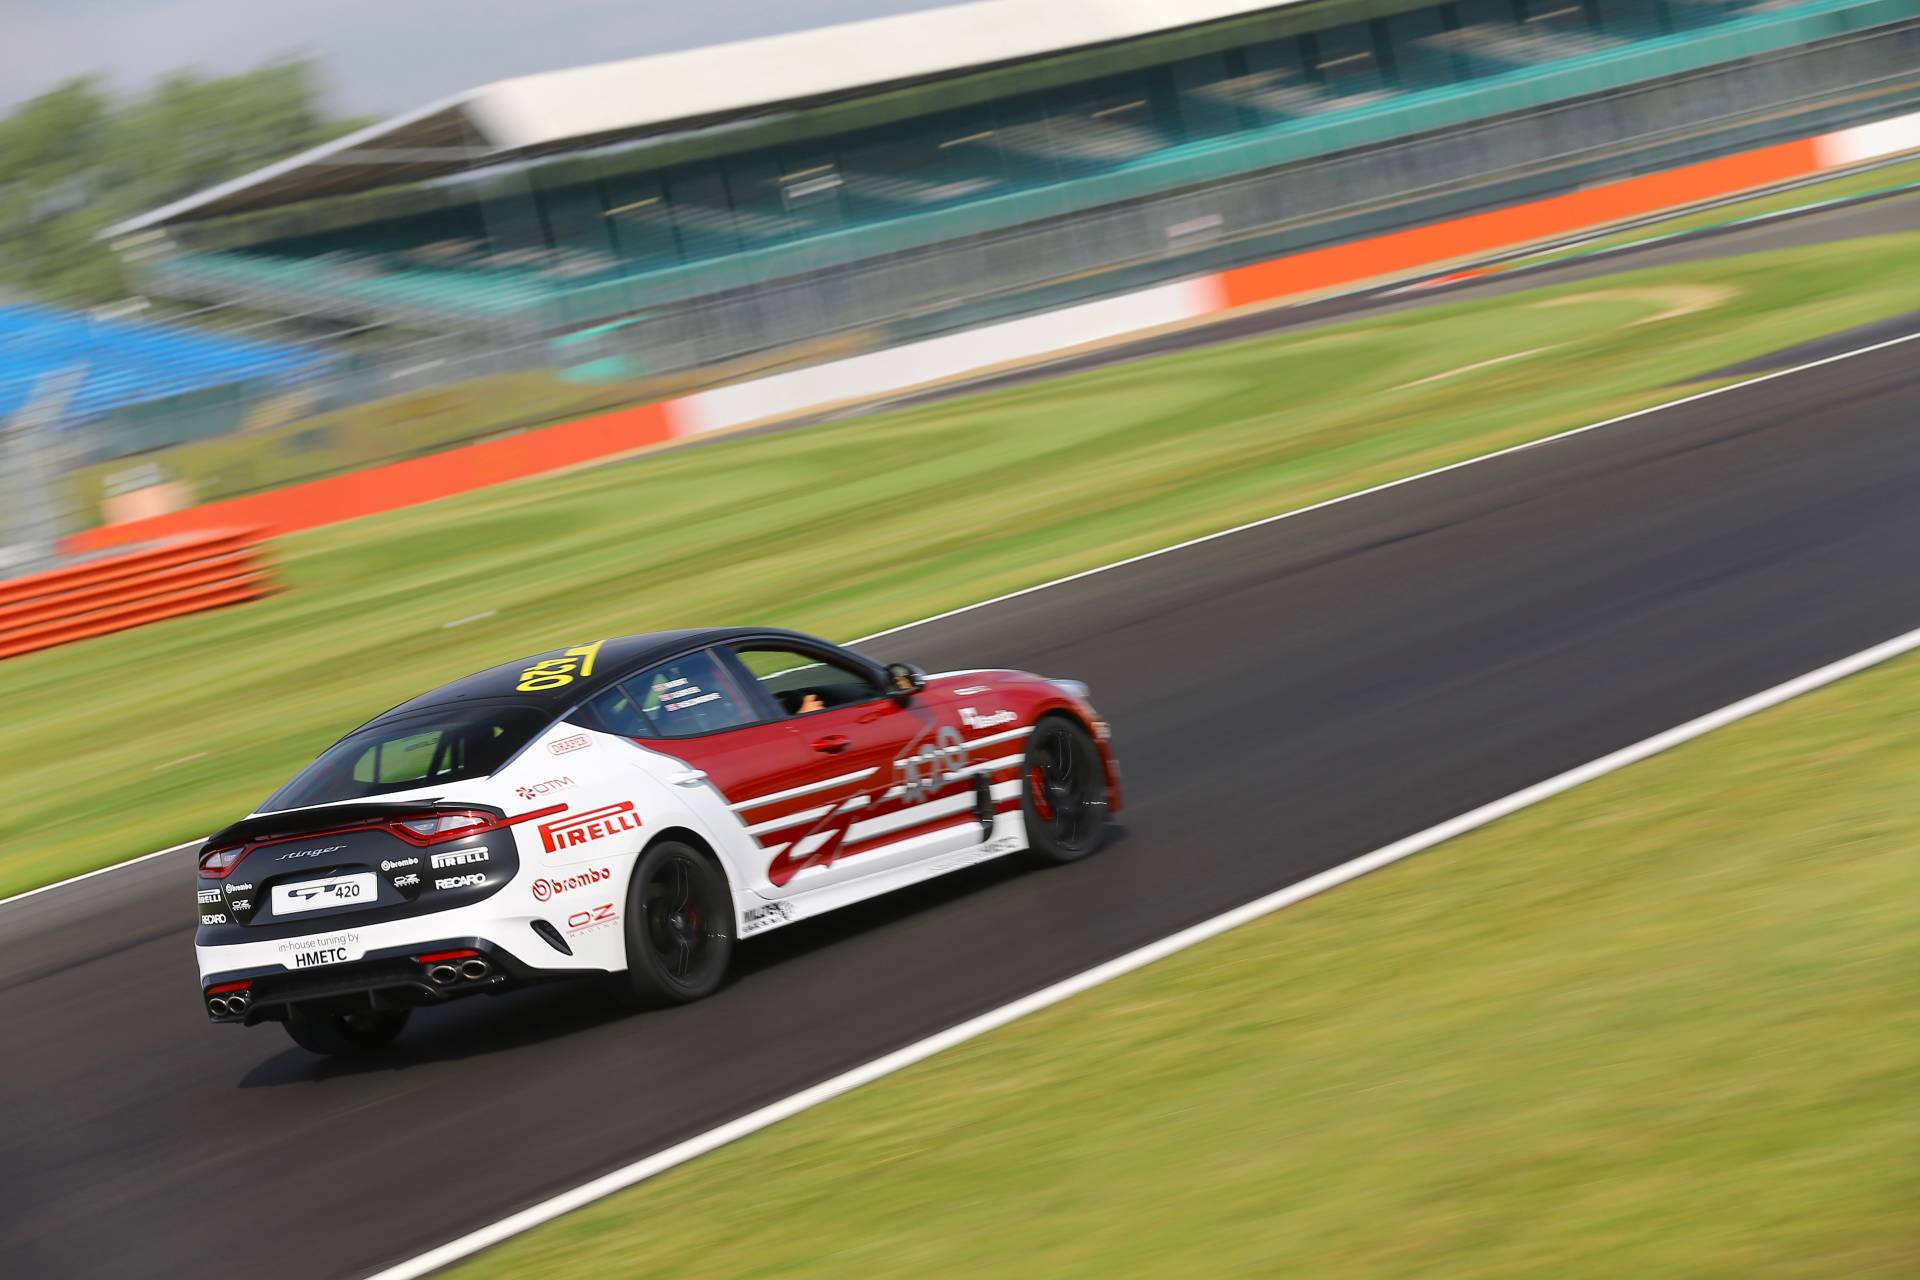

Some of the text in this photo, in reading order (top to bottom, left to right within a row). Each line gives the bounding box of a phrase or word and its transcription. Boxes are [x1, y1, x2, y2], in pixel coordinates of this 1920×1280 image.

[515, 657, 578, 692] 420
[537, 800, 643, 854] PIRELLI
[390, 857, 419, 869] brembo
[430, 846, 489, 869] PIRELLI
[435, 873, 486, 890] RECARO
[551, 867, 611, 894] brembo
[335, 884, 360, 899] 420
[201, 913, 227, 924] RECARO
[278, 933, 360, 953] in-house tuning by
[295, 947, 347, 967] HMETC
